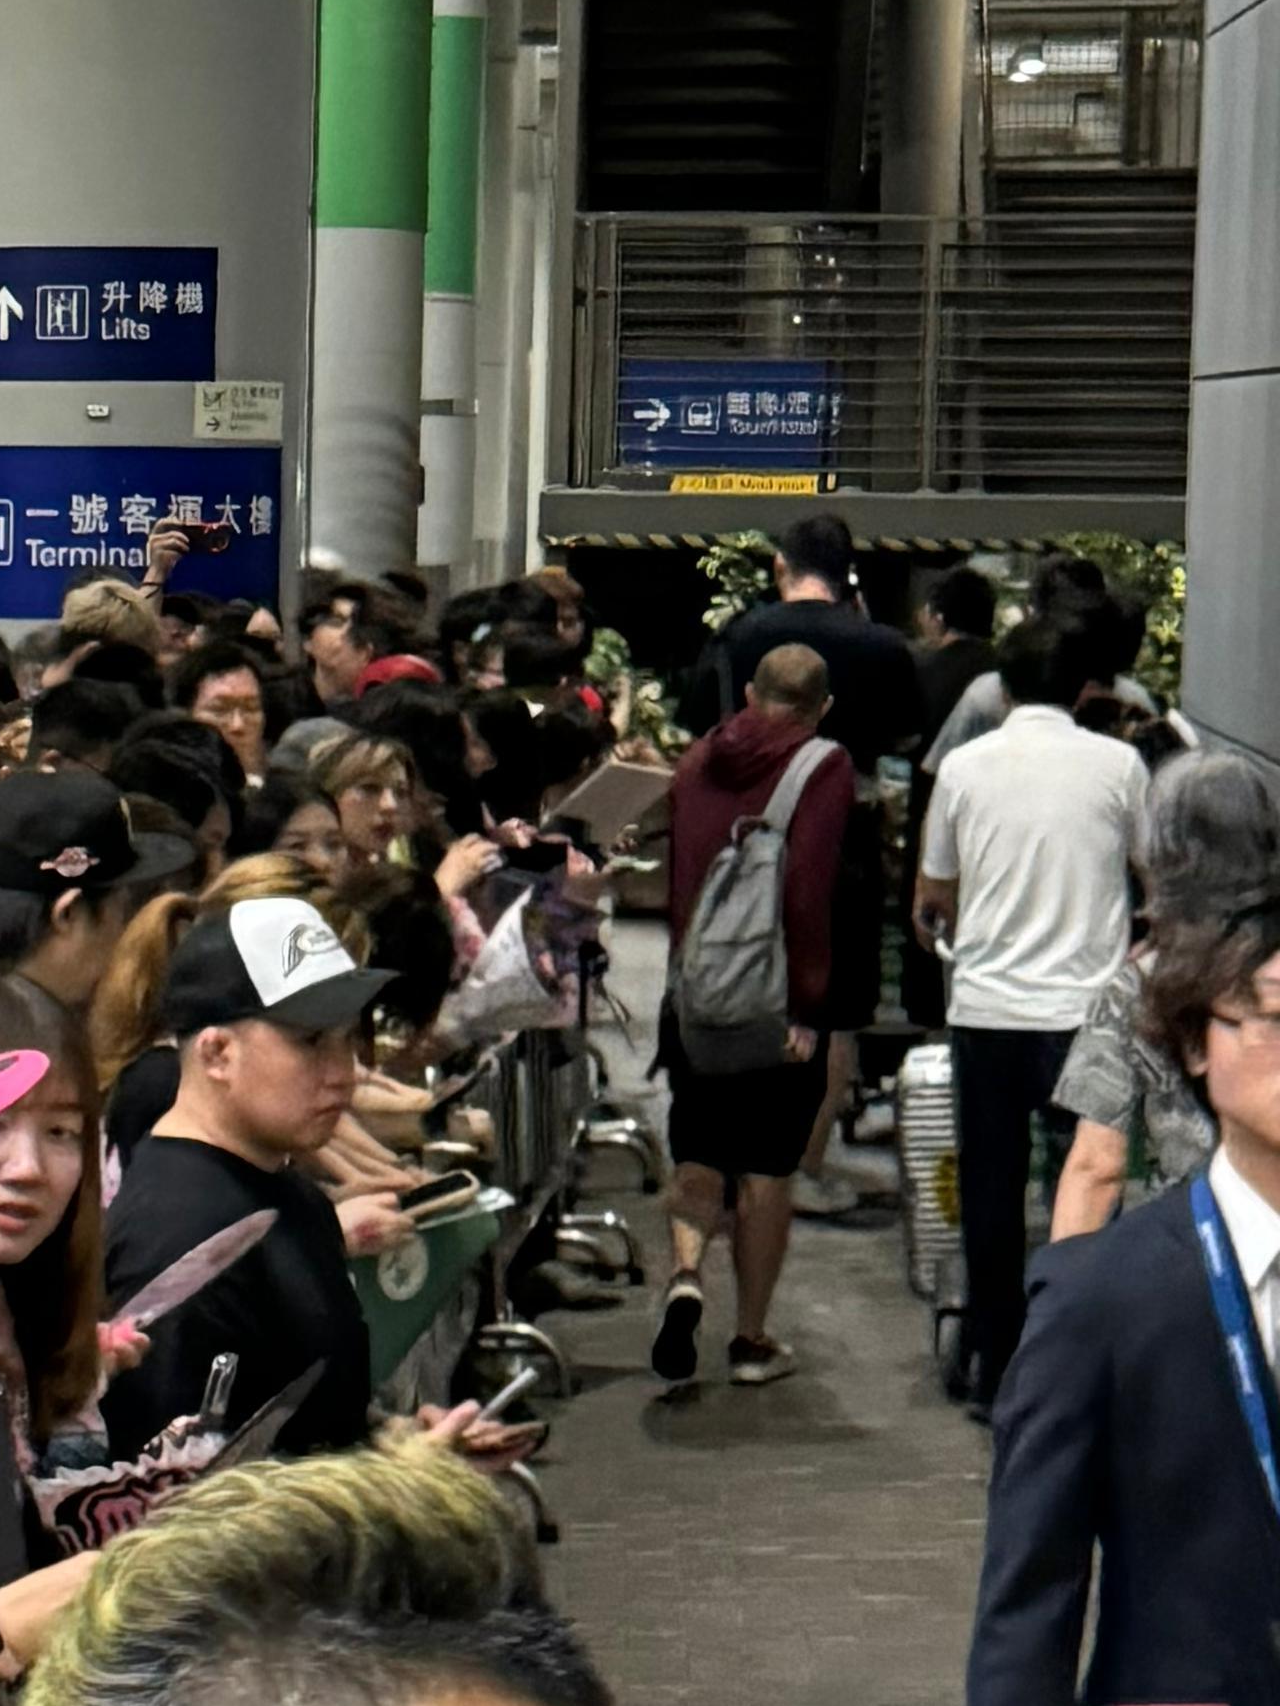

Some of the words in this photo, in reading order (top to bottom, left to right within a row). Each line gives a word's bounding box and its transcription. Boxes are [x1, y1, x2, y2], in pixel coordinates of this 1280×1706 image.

[101, 280, 204, 315] 升降機
[100, 316, 151, 341] Lifts
